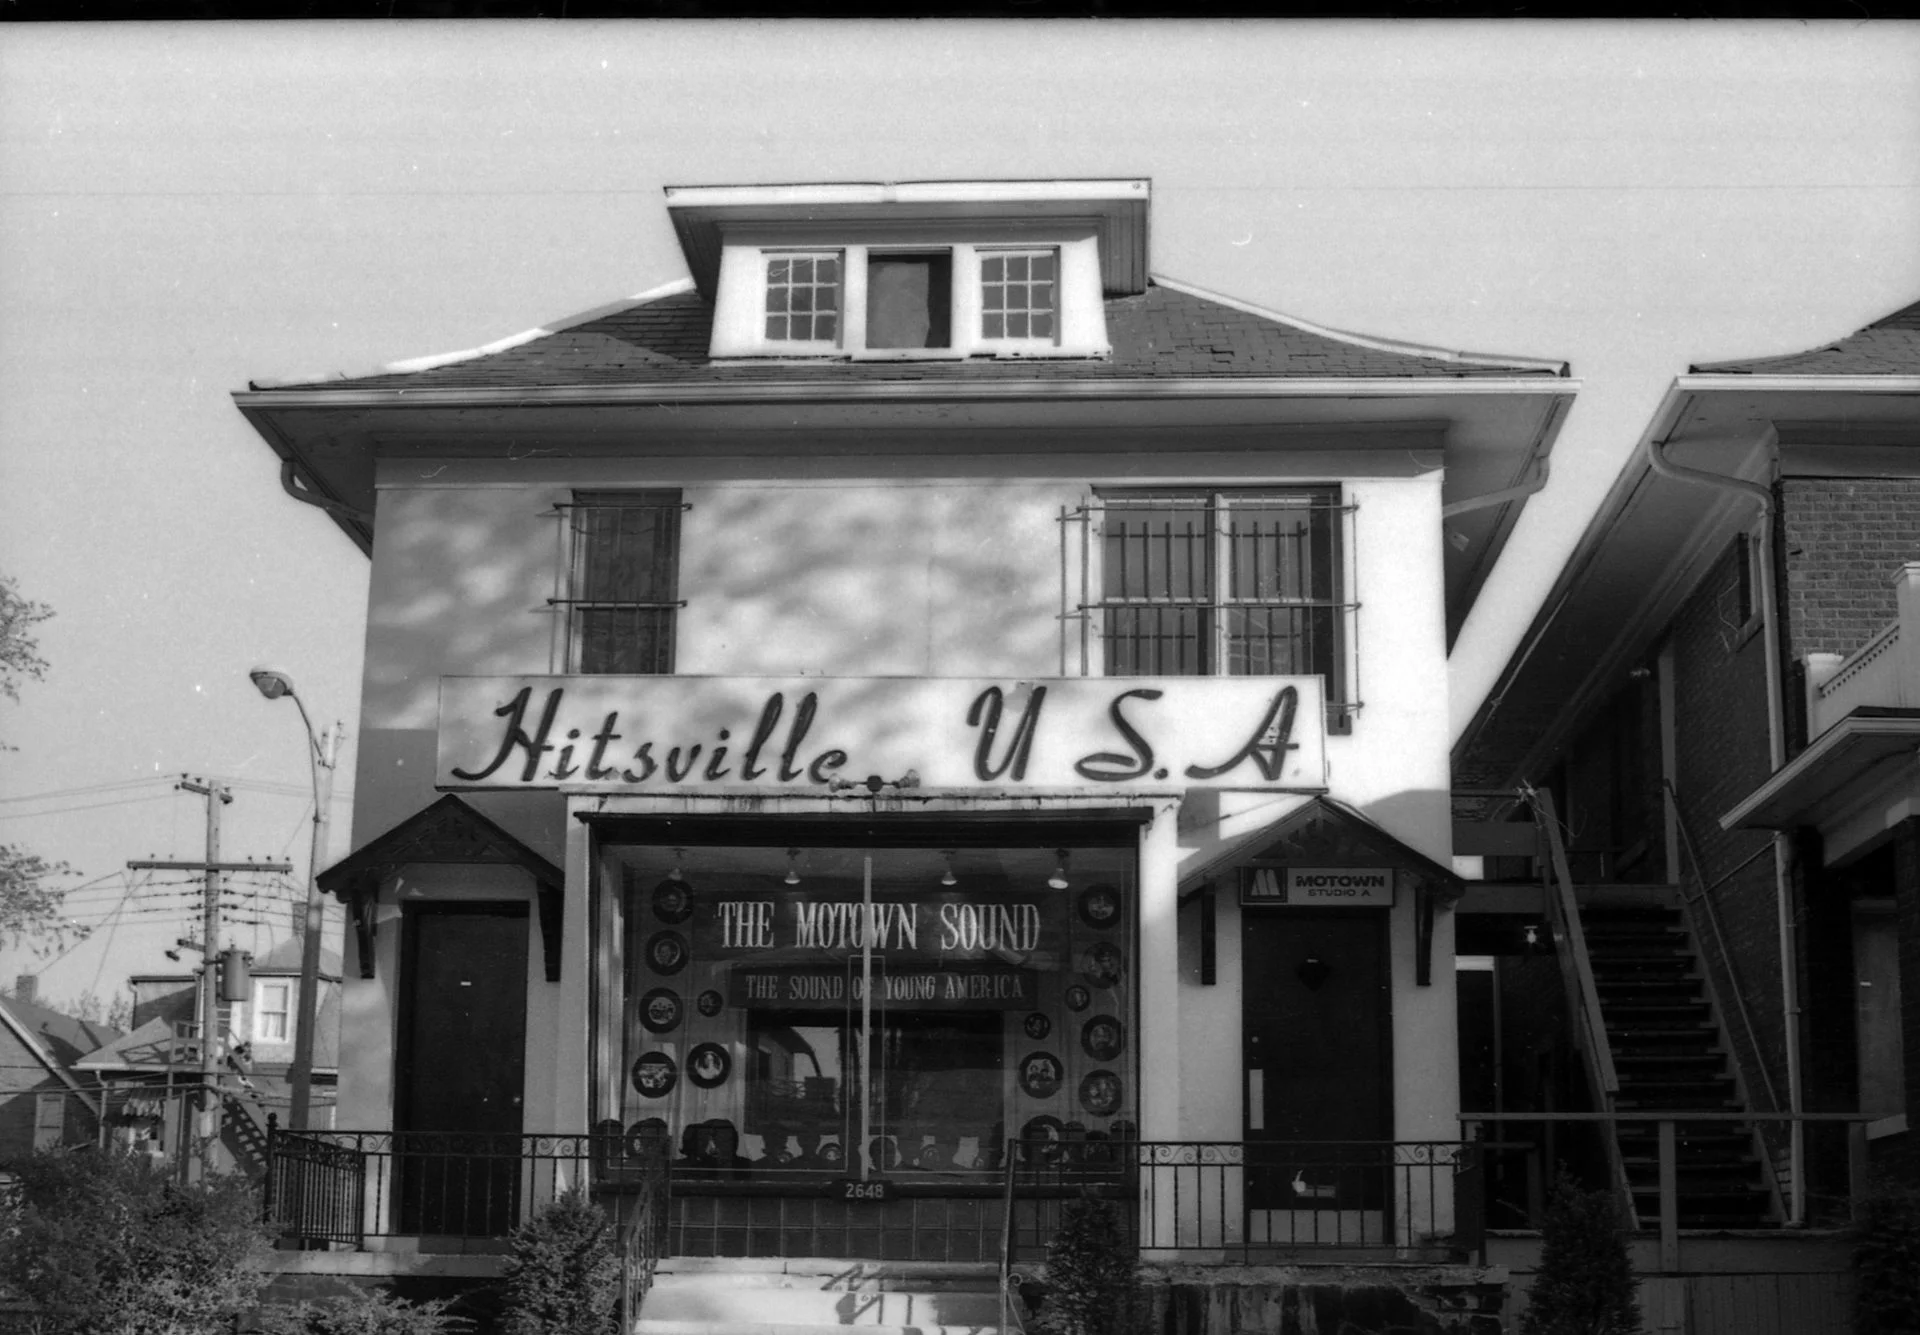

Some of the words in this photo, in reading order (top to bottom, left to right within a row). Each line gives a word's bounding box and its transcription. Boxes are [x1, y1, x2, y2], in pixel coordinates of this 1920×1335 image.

[452, 686, 848, 783] Hitsville
[1295, 875, 1385, 887] MOTOWN
[1307, 888, 1356, 897] STUDIO
[1360, 888, 1371, 897] A
[716, 900, 775, 949] THE
[794, 901, 918, 951] MOTOWN
[940, 902, 1041, 952] SOUND
[745, 975, 779, 1000] THE
[788, 975, 844, 1001] SOUND
[851, 975, 878, 1001] O
[883, 975, 936, 1001] YOUNG
[944, 974, 1024, 1000] AMERICA
[844, 1183, 885, 1199] 2648
